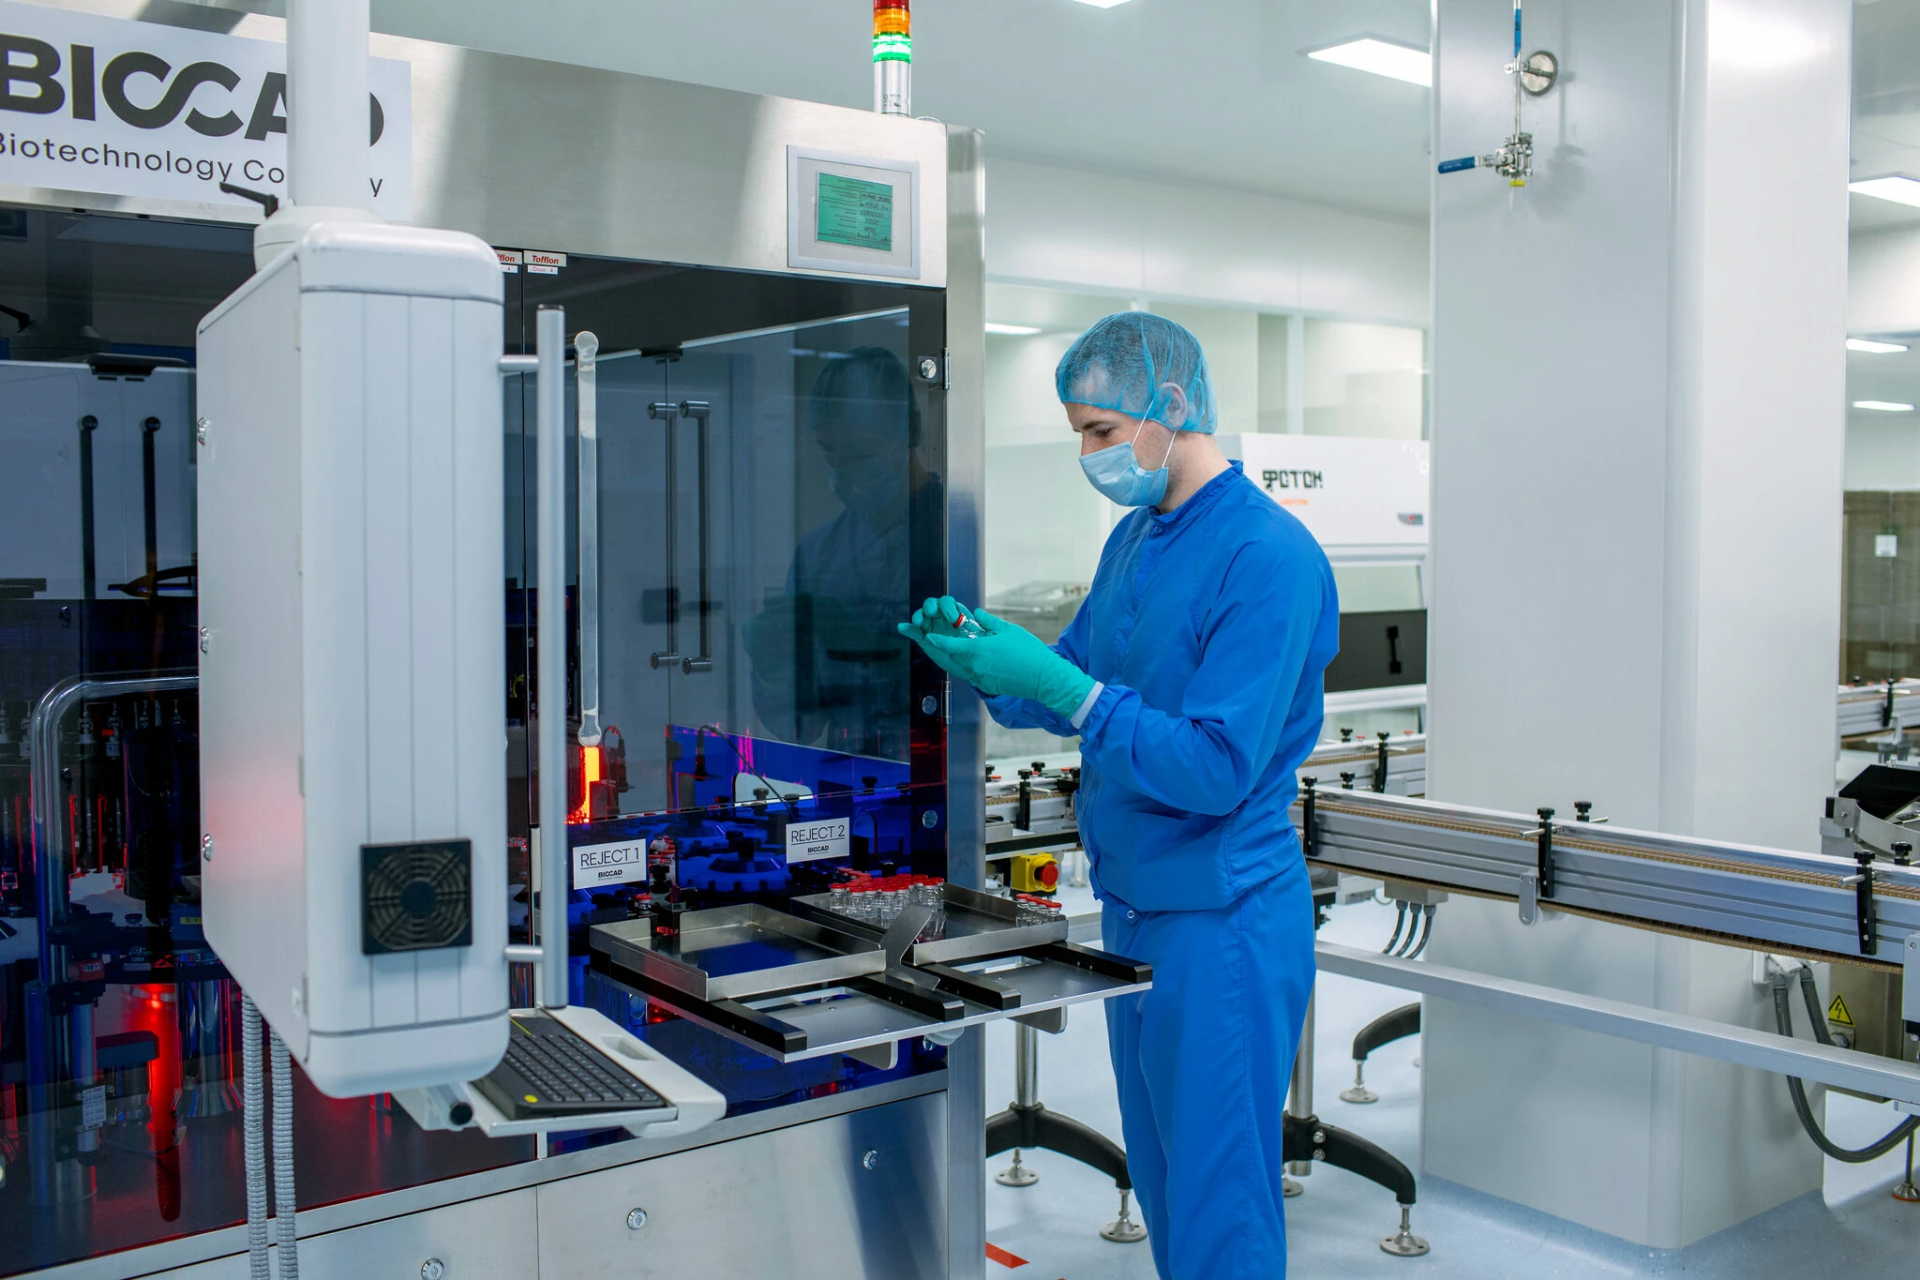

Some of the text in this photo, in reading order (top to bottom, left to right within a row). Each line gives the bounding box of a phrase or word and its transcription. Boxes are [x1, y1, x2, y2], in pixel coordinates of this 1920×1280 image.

[0, 33, 385, 147] BIOCA
[532, 255, 559, 265] Tofflon
[791, 824, 845, 843] REJECT 2
[807, 845, 830, 853] BIOCAD
[580, 846, 639, 867] REJECT 1
[598, 869, 623, 878] BIOCAD
